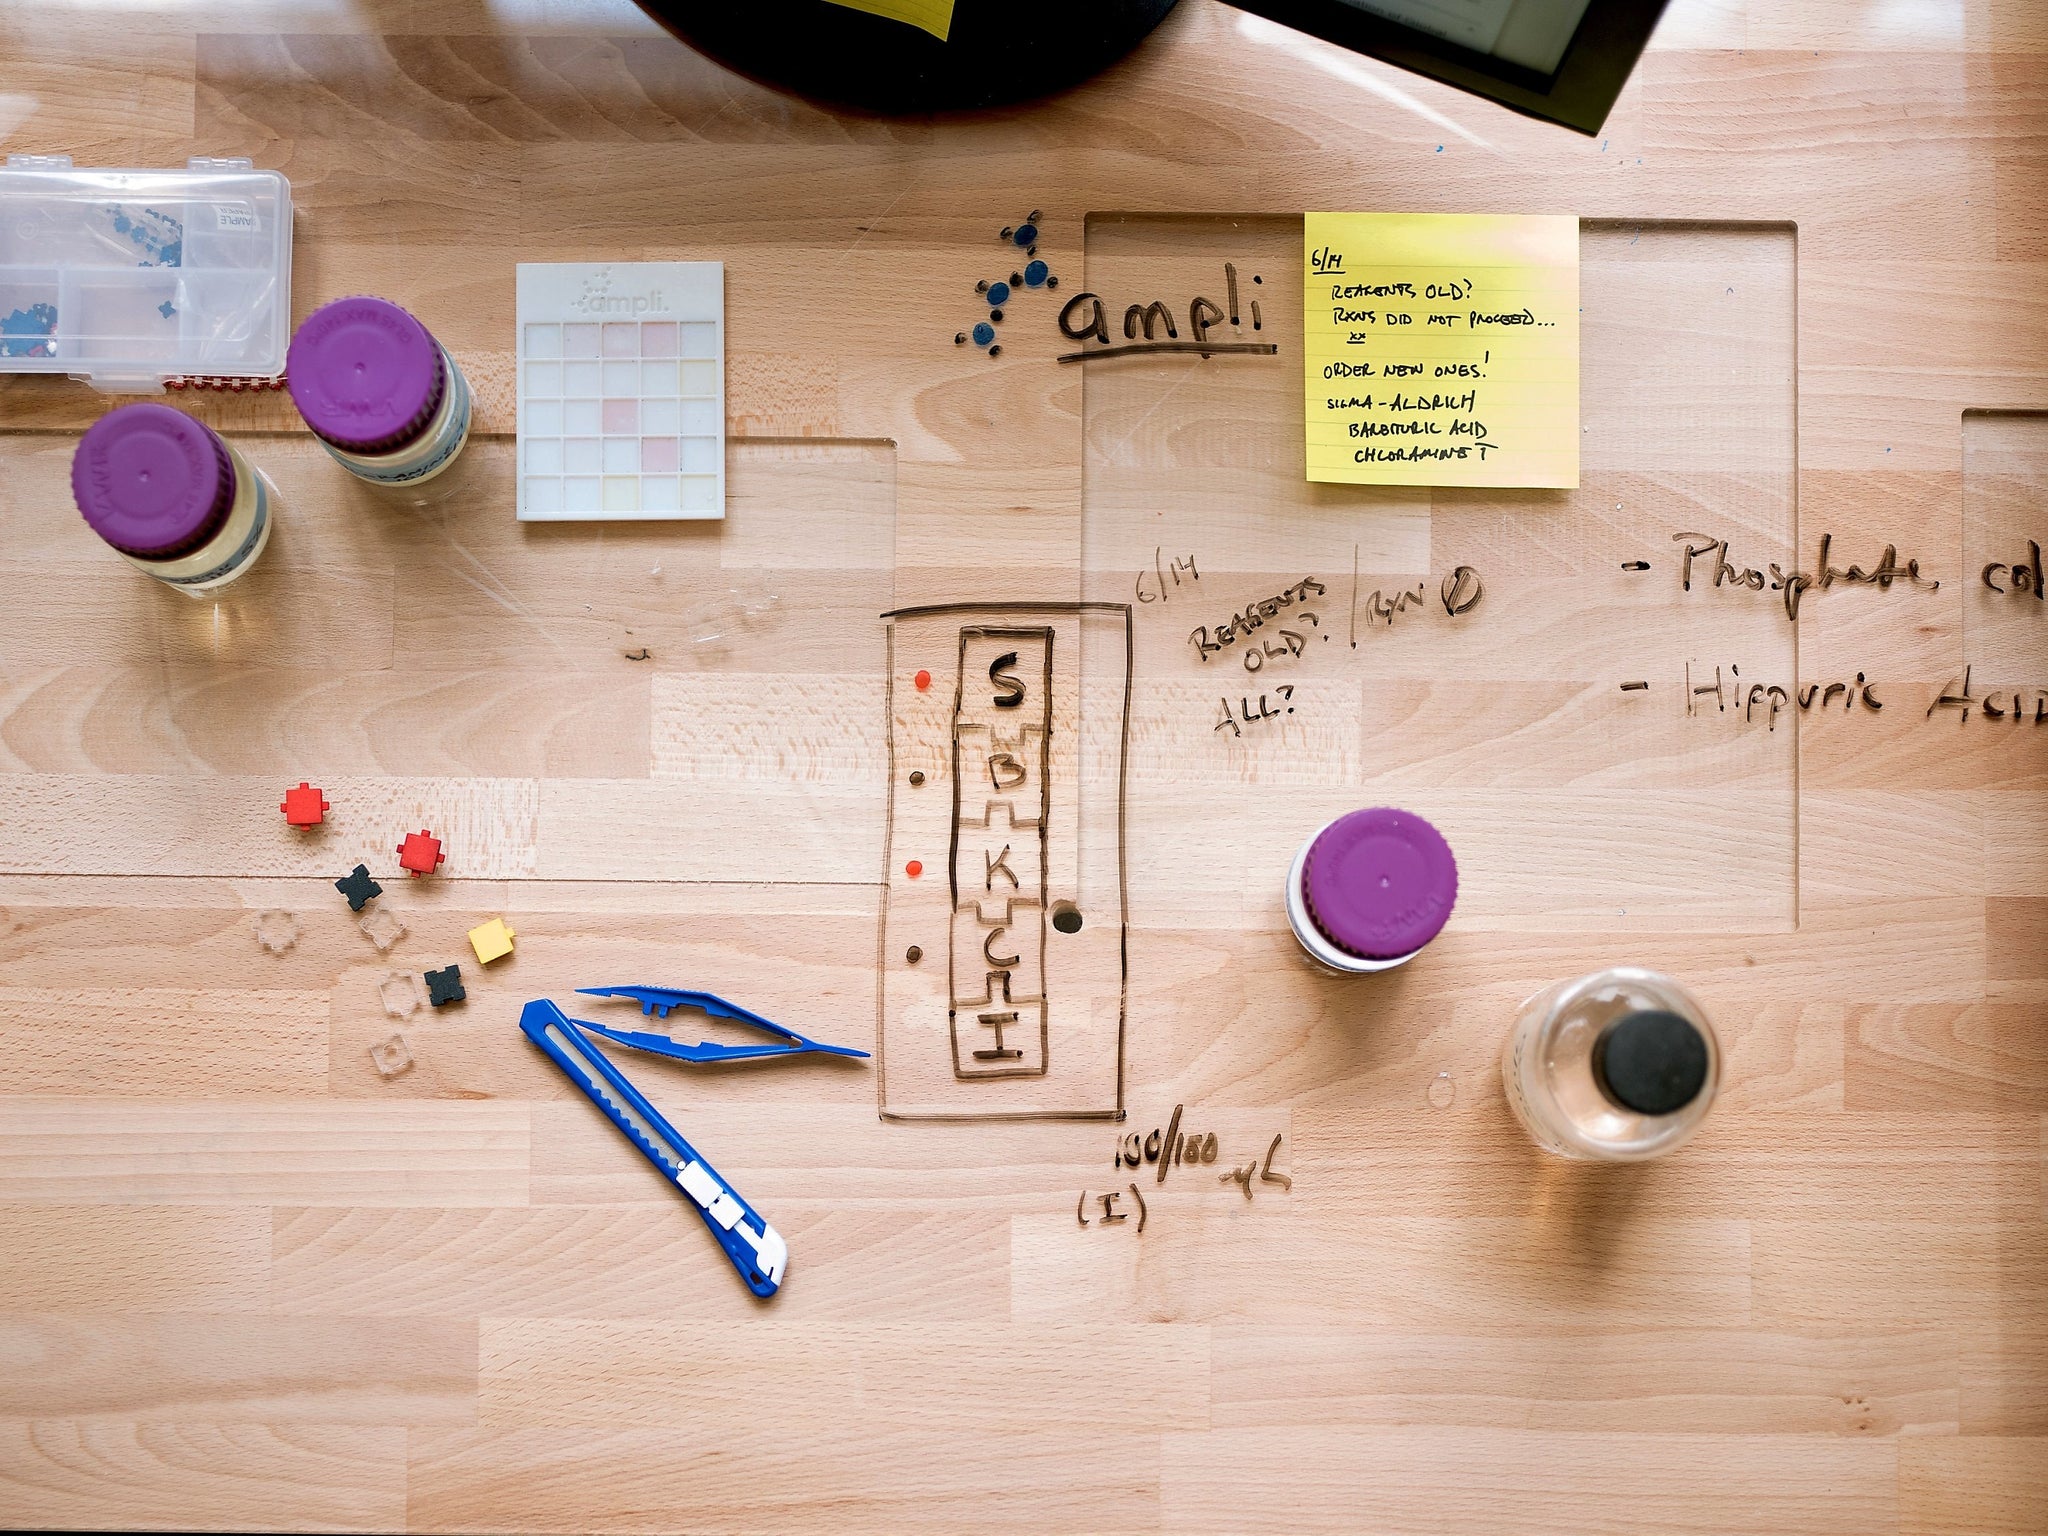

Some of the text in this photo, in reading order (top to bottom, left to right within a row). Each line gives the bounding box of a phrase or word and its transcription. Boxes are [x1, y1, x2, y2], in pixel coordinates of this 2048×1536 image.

[1311, 246, 1343, 272] 6/14
[1331, 278, 1473, 301] REAGENTS OLD?
[1057, 261, 1263, 360] ampli
[1386, 312, 1412, 326] DID
[1427, 313, 1461, 327] NOT
[1323, 350, 1490, 379] ORDER NEW ONES!
[1348, 418, 1488, 439] BARBITURIC ACID
[1354, 446, 1472, 463] CHLORAMINE
[1135, 546, 1200, 603] 6/14
[988, 651, 1027, 707] S
[988, 753, 1027, 790] B
[985, 843, 1019, 891] K
